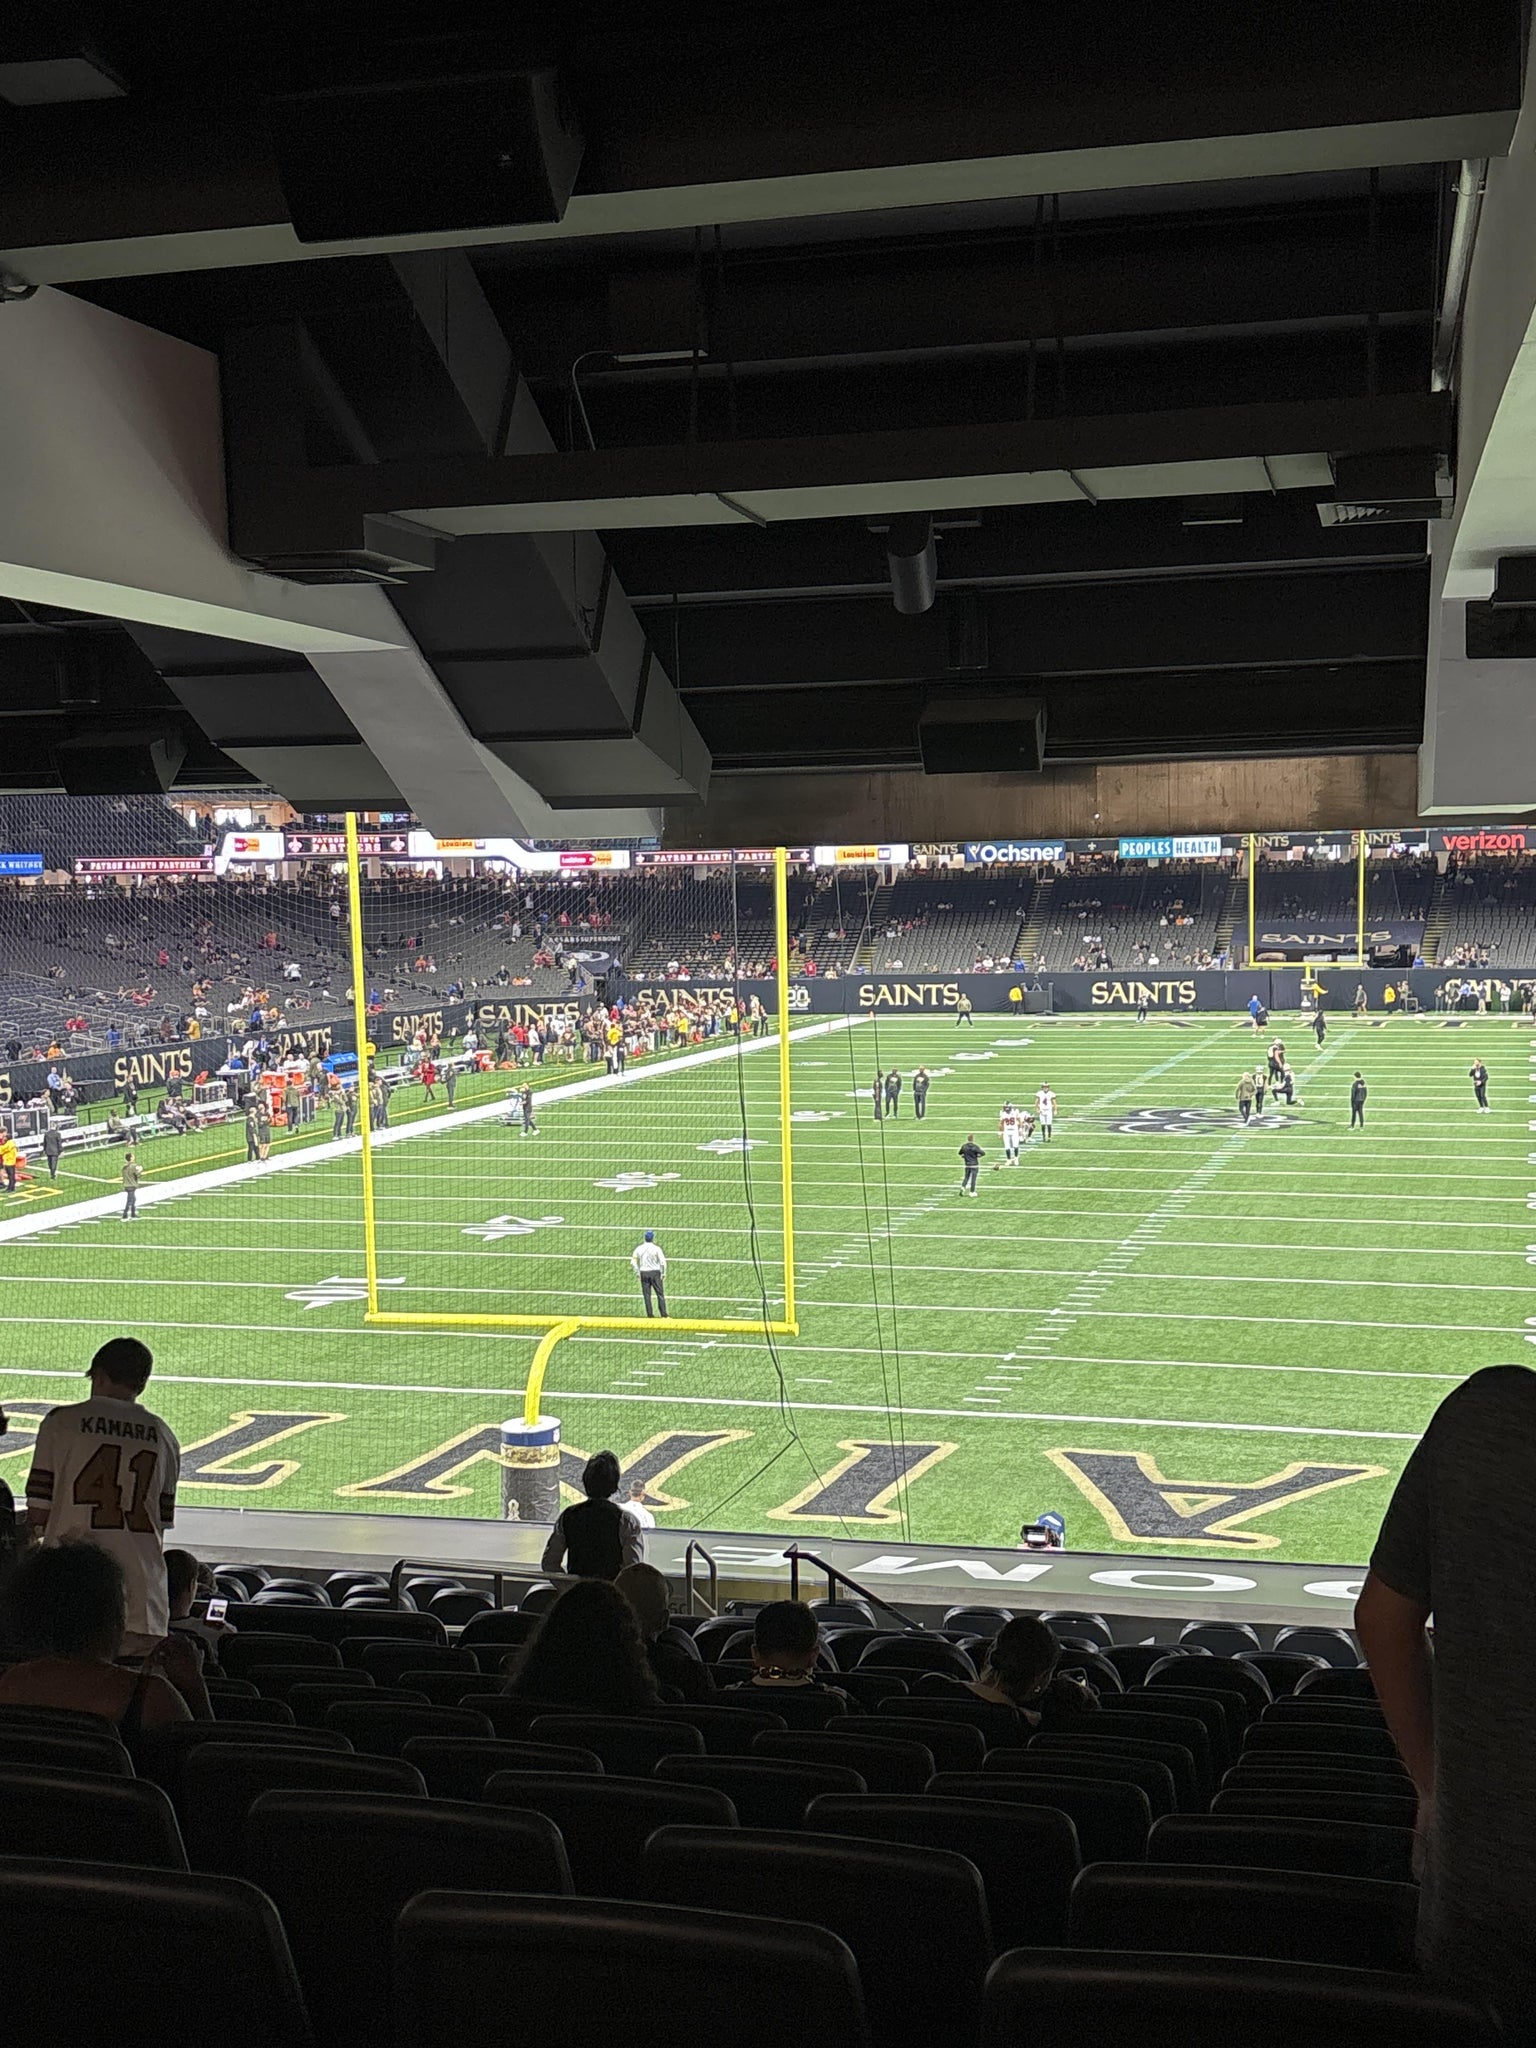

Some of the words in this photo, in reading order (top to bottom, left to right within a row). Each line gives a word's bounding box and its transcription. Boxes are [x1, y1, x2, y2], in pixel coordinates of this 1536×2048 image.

[312, 843, 382, 852] PARTERS
[912, 843, 959, 856] SAINTS
[1121, 841, 1171, 856] PEOPLES
[1175, 840, 1218, 854] HEALTH
[1442, 831, 1525, 850] verizon
[654, 854, 693, 862] PATRON
[980, 843, 1064, 862] Ochsner
[90, 861, 123, 870] PATRON
[125, 861, 157, 870] SAINTS
[159, 861, 201, 869] PARTNERS
[1260, 930, 1392, 945] SAINTS
[859, 983, 960, 1007] SAINTS
[1091, 980, 1196, 1005] SAINTS
[114, 1047, 193, 1088] SAINTS
[81, 1416, 158, 1443] KAMARA
[73, 1443, 158, 1533] 41
